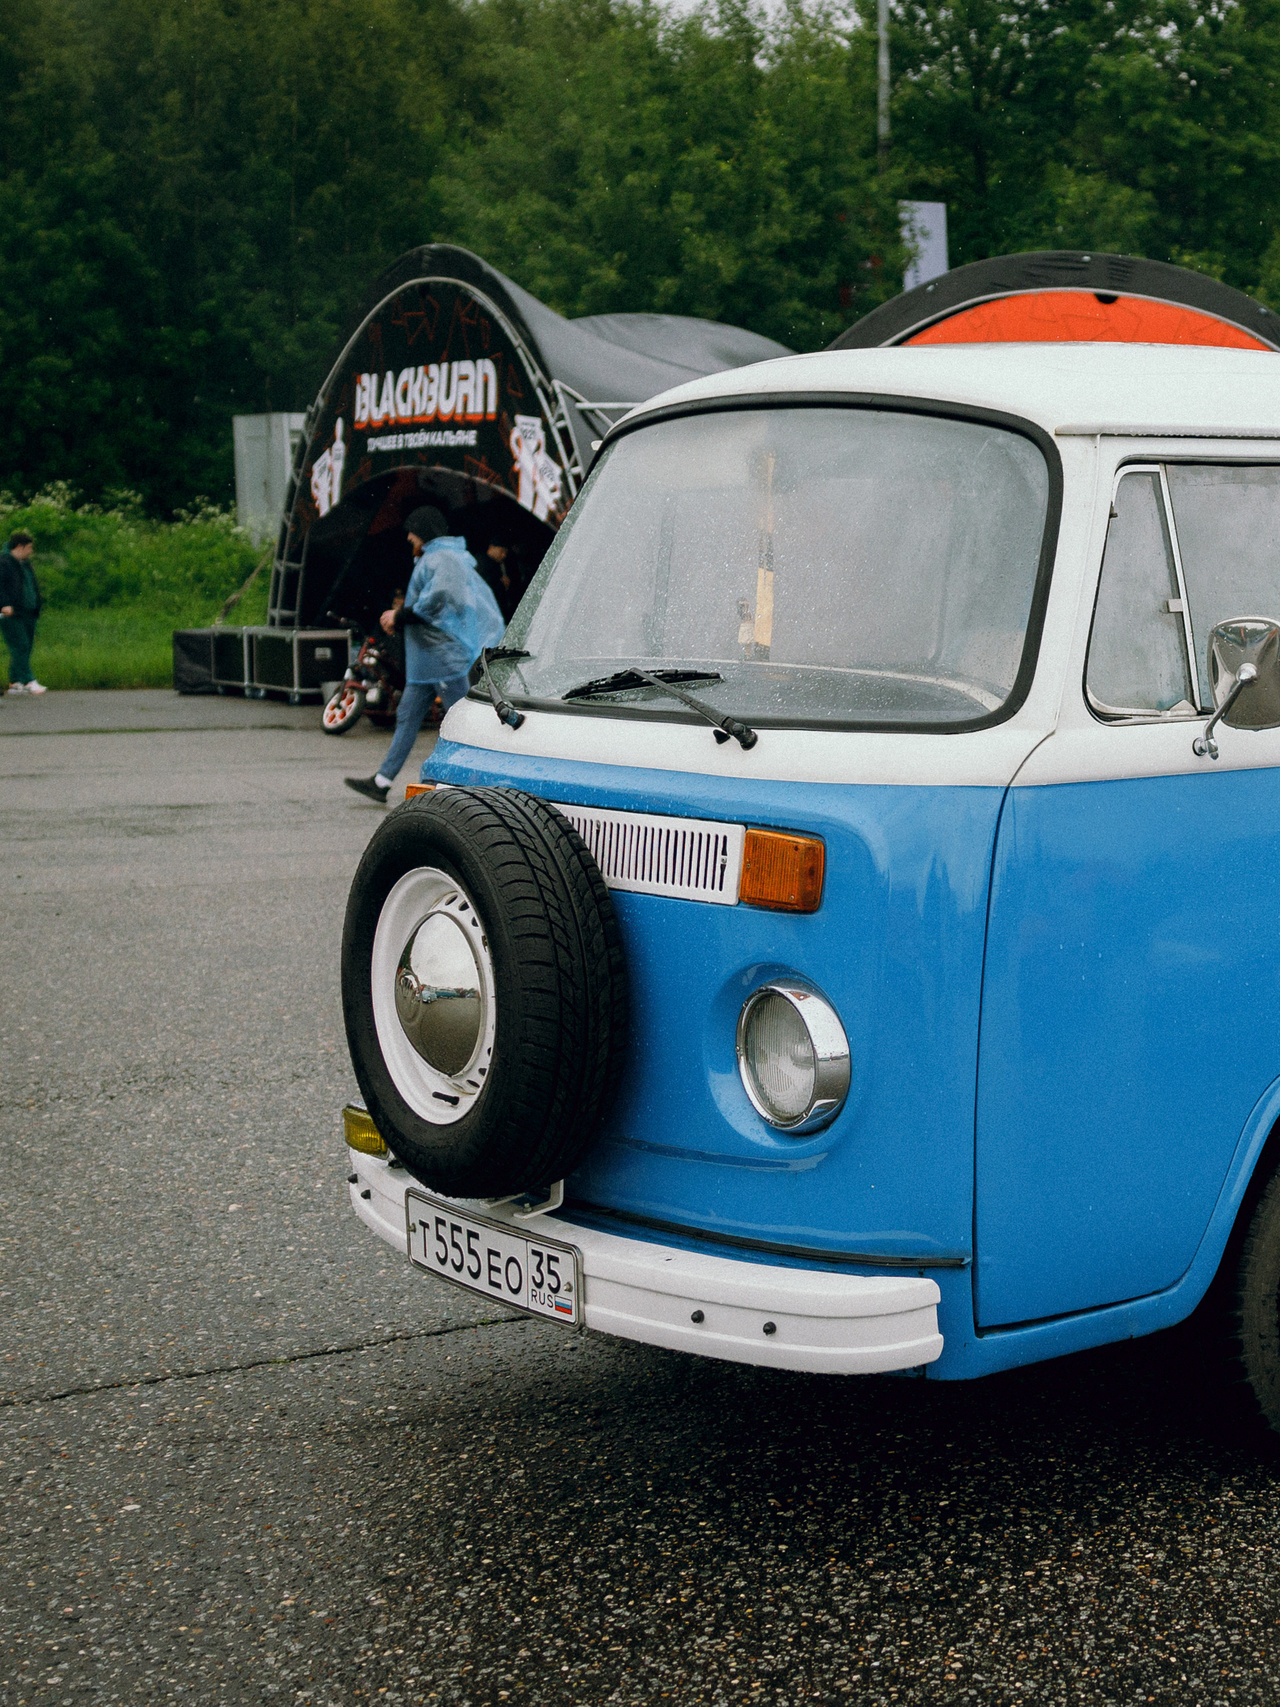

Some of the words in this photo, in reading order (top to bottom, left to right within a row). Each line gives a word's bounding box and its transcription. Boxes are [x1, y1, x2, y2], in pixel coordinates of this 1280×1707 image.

[354, 358, 497, 428] BLACKBURN
[531, 1249, 561, 1294] 35
[531, 1288, 553, 1308] RUS
